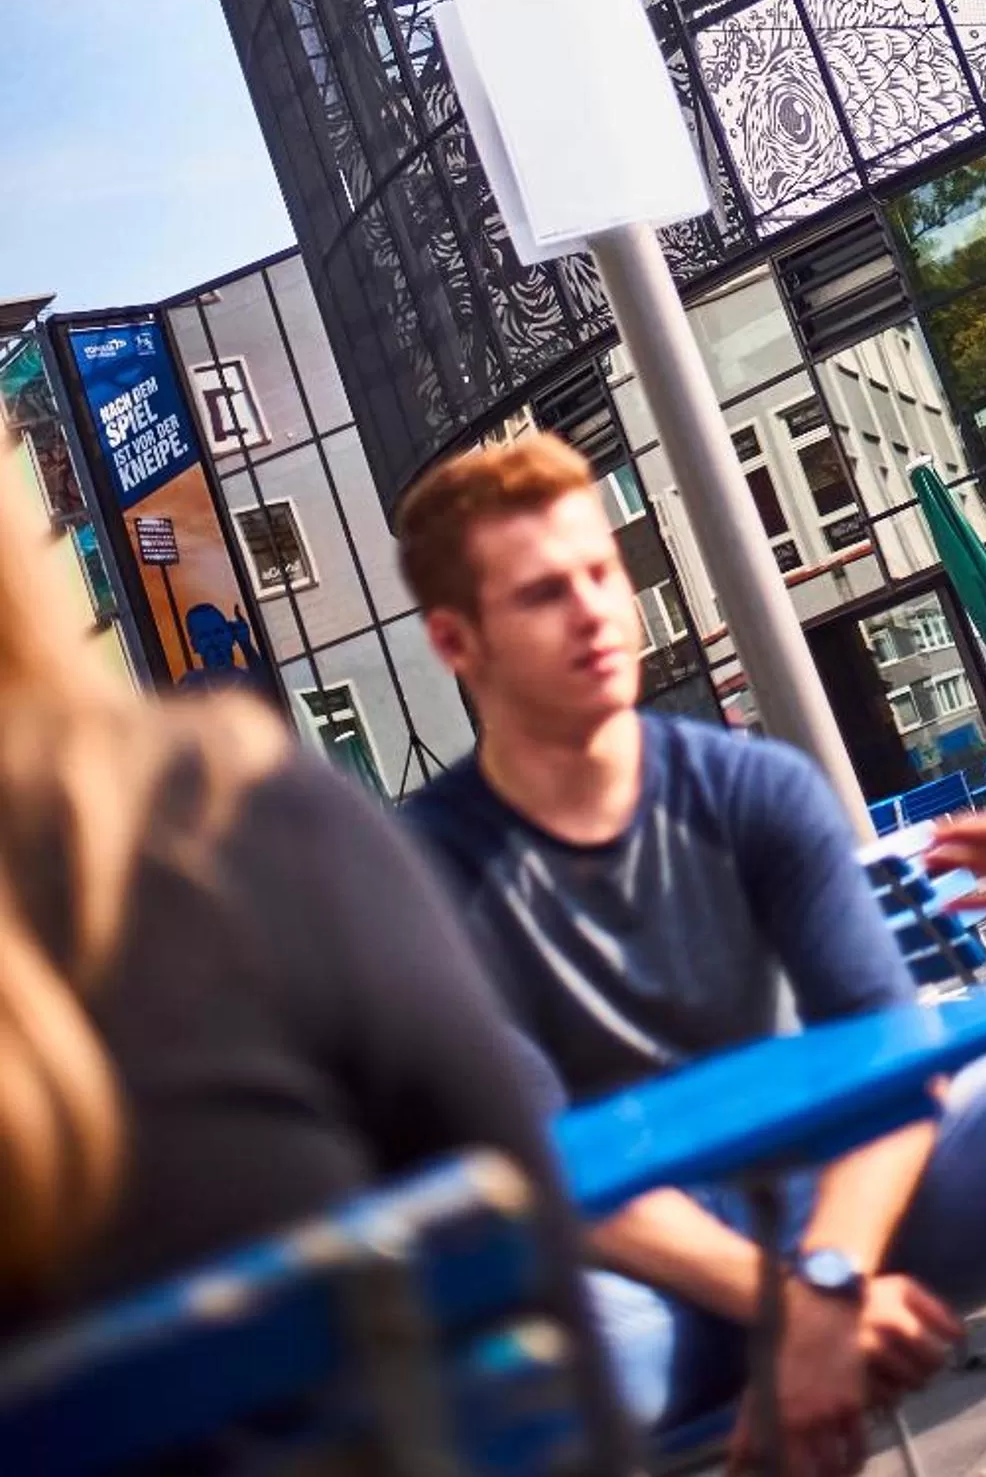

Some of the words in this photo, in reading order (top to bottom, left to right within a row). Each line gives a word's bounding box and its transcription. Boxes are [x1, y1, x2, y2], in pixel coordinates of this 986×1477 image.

[100, 390, 133, 423] NACH
[131, 376, 159, 404] DEM
[105, 400, 158, 448] SPIEL
[113, 443, 132, 467] IST
[132, 432, 156, 454] VOR
[156, 414, 181, 436] DER
[117, 431, 189, 492] KNEIPE.
